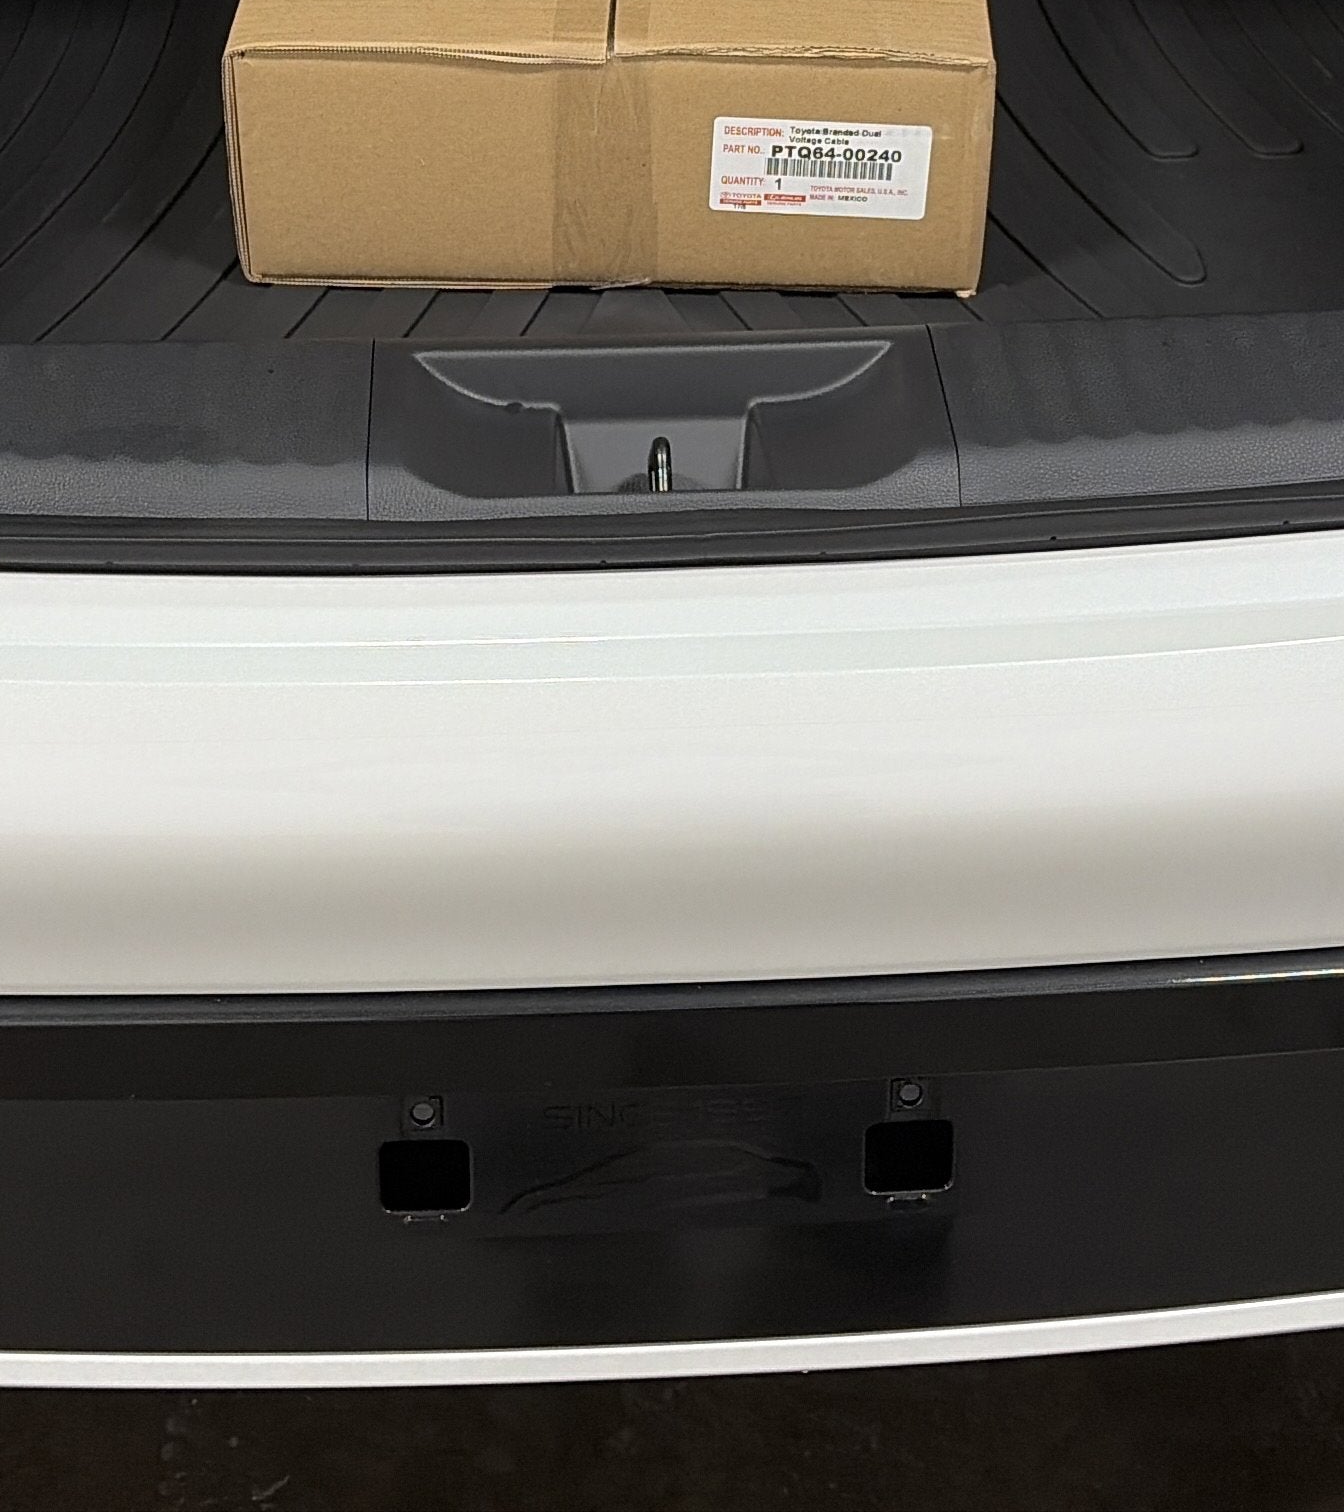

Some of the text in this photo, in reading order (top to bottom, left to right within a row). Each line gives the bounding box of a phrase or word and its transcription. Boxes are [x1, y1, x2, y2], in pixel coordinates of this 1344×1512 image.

[724, 125, 785, 137] DESCRIPTION:
[790, 126, 821, 136] Toyota
[862, 129, 882, 138] Dual
[789, 136, 850, 146] Voltage Cable
[722, 144, 745, 153] PART
[771, 145, 902, 162] PTQ64-00240
[774, 178, 782, 190] 1
